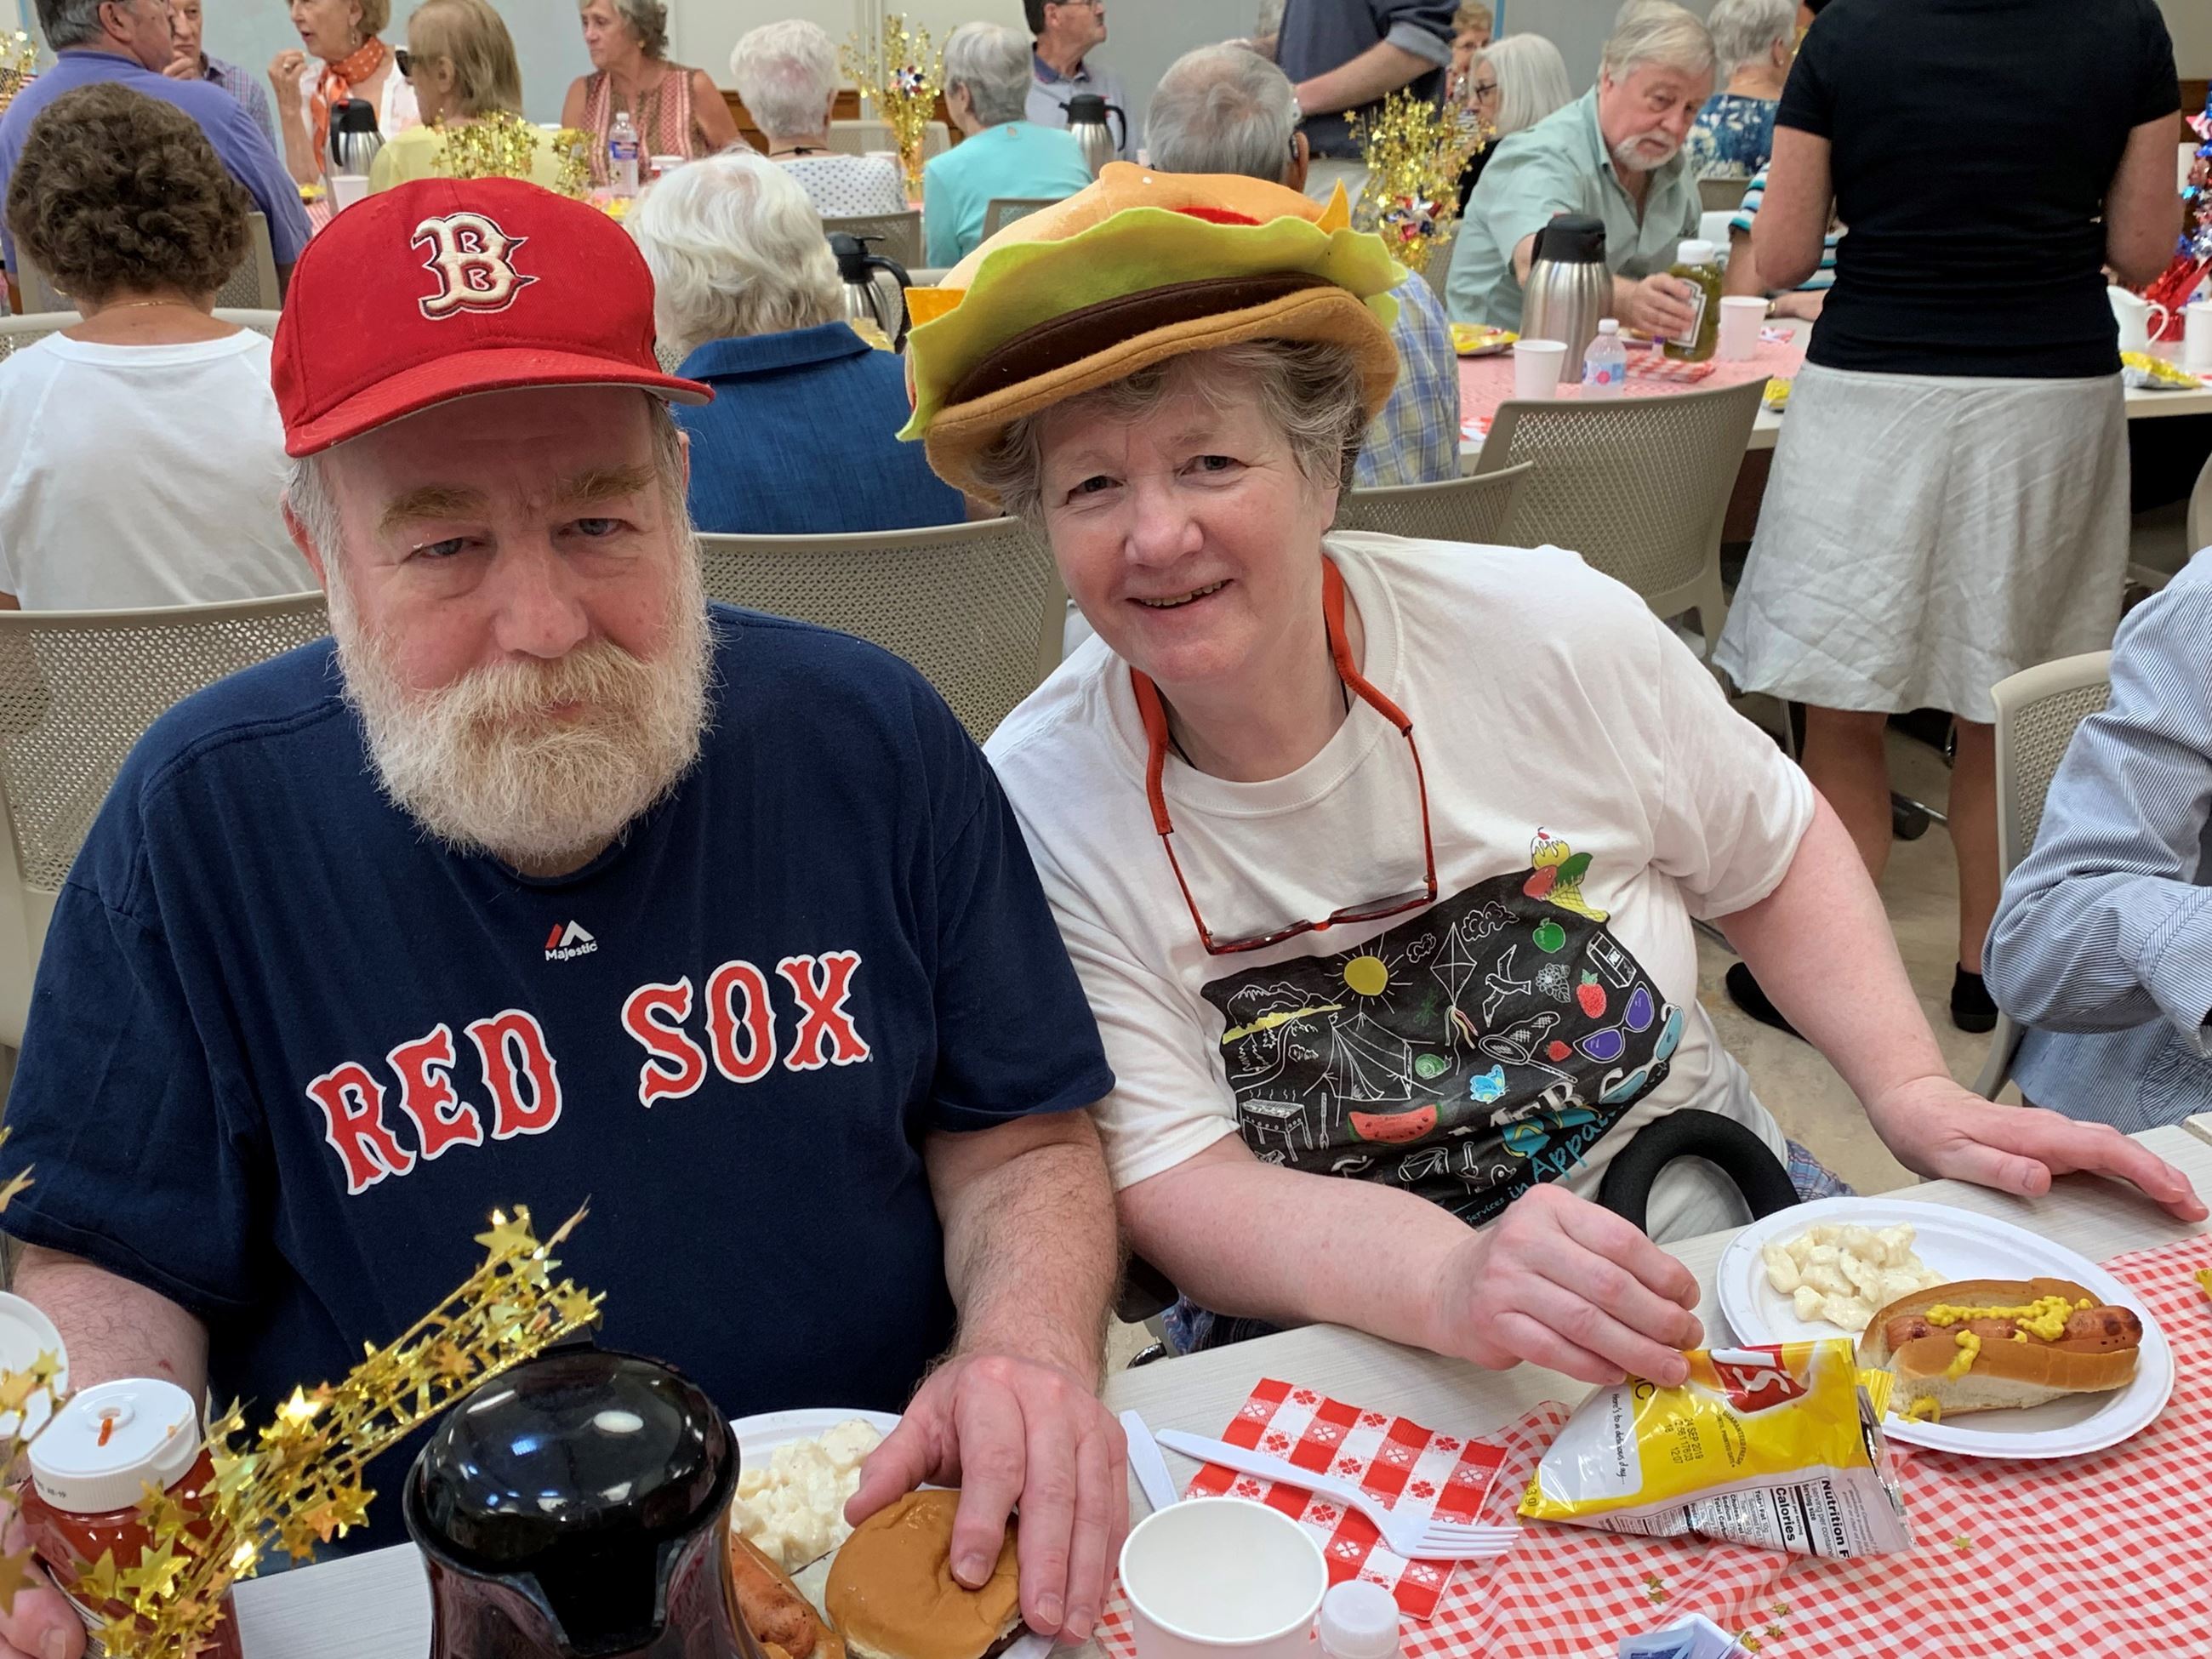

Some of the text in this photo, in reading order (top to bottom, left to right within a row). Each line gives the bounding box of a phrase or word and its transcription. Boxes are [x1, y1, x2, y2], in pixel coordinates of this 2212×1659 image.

[410, 212, 540, 321] B
[544, 943, 598, 962] Majestic
[305, 949, 870, 1195] RED SOX
[1508, 1182, 1530, 1200] in
[1687, 1427, 1699, 1442] SEP
[1691, 1442, 1704, 1460] 2019
[1776, 1487, 1796, 1542] Calories
[1802, 1483, 1817, 1521] Serving size
[1811, 1486, 1823, 1514] serving
[1821, 1479, 1850, 1559] Nutrition F
